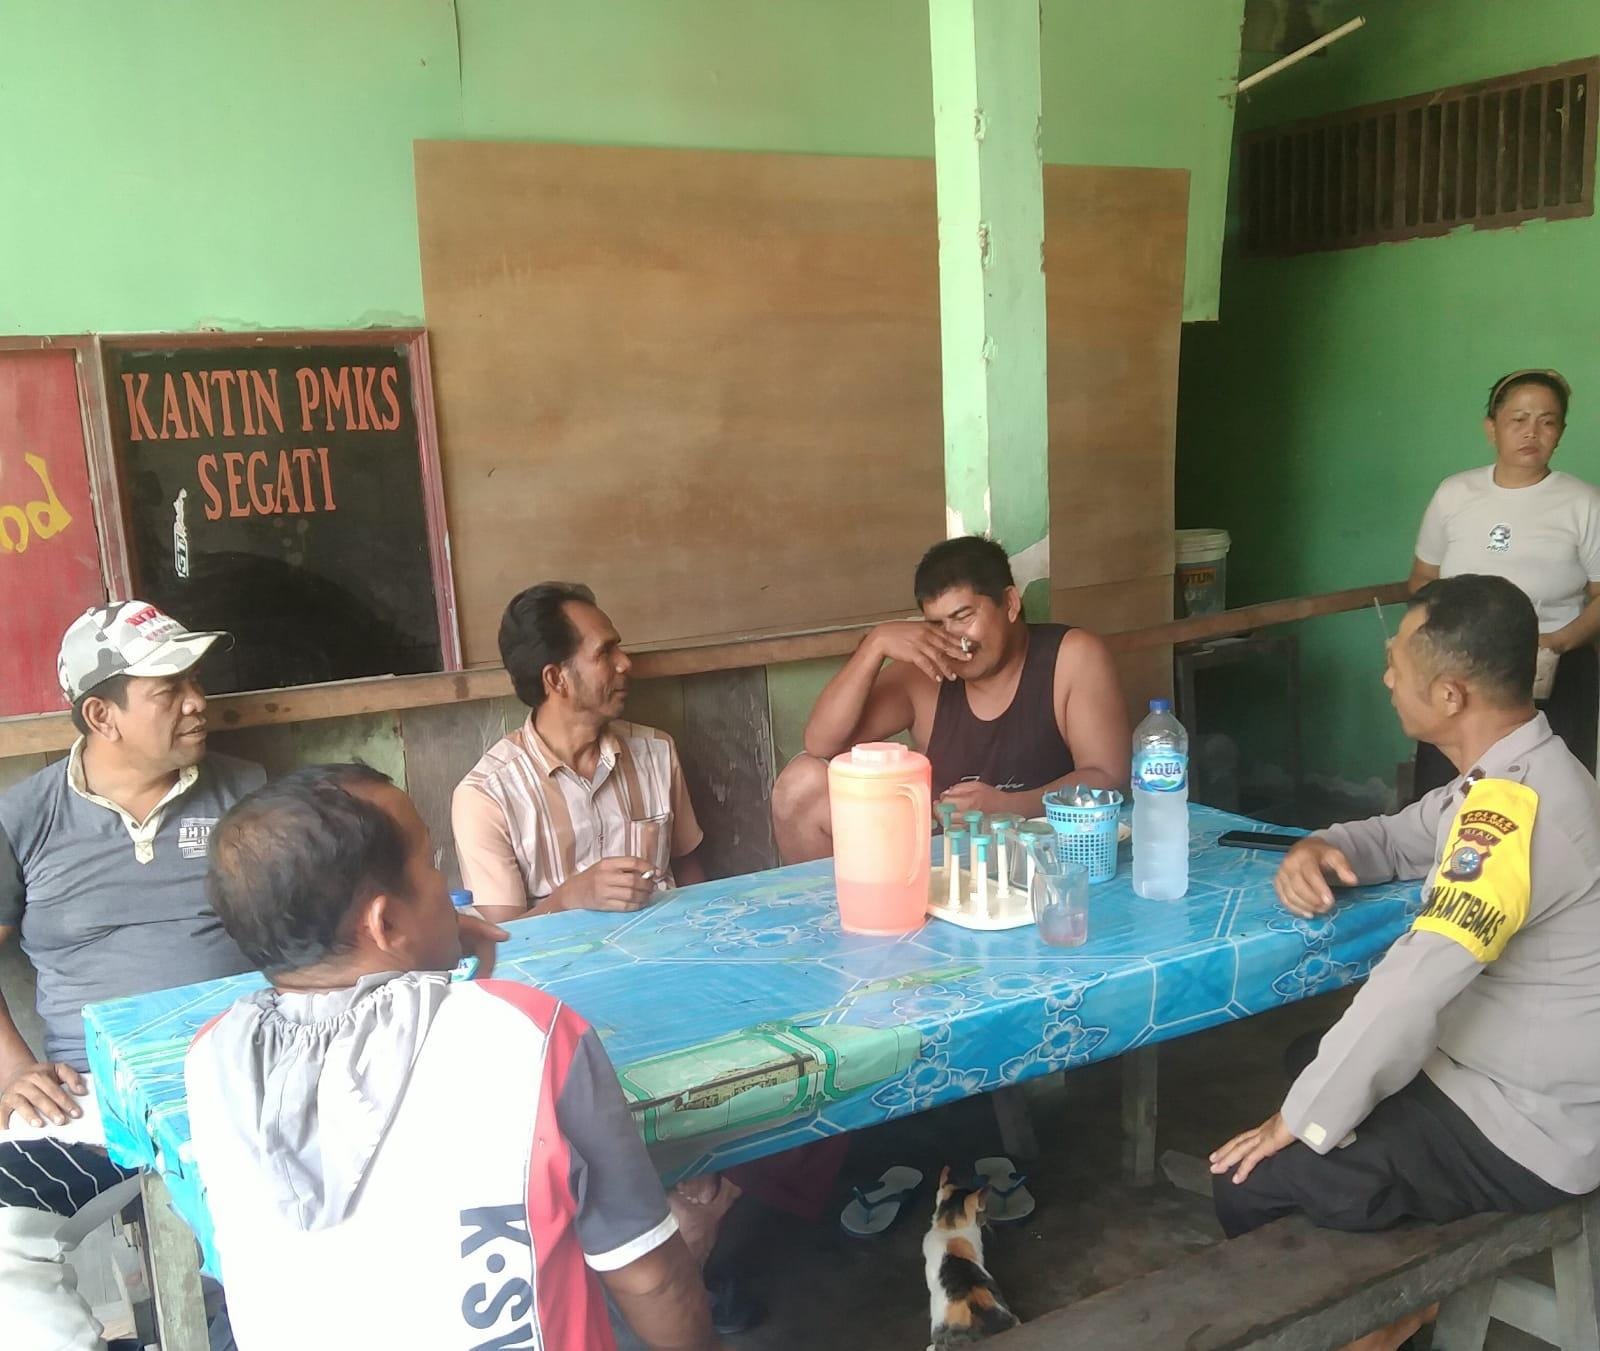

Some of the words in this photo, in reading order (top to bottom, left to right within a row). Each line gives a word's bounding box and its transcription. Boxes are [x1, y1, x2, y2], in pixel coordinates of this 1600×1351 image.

[121, 369, 284, 441] KANTIN
[295, 366, 401, 432] PMKS
[197, 447, 337, 521] SEGATI
[1144, 762, 1182, 778] AQUA
[1463, 829, 1495, 841] RIAU
